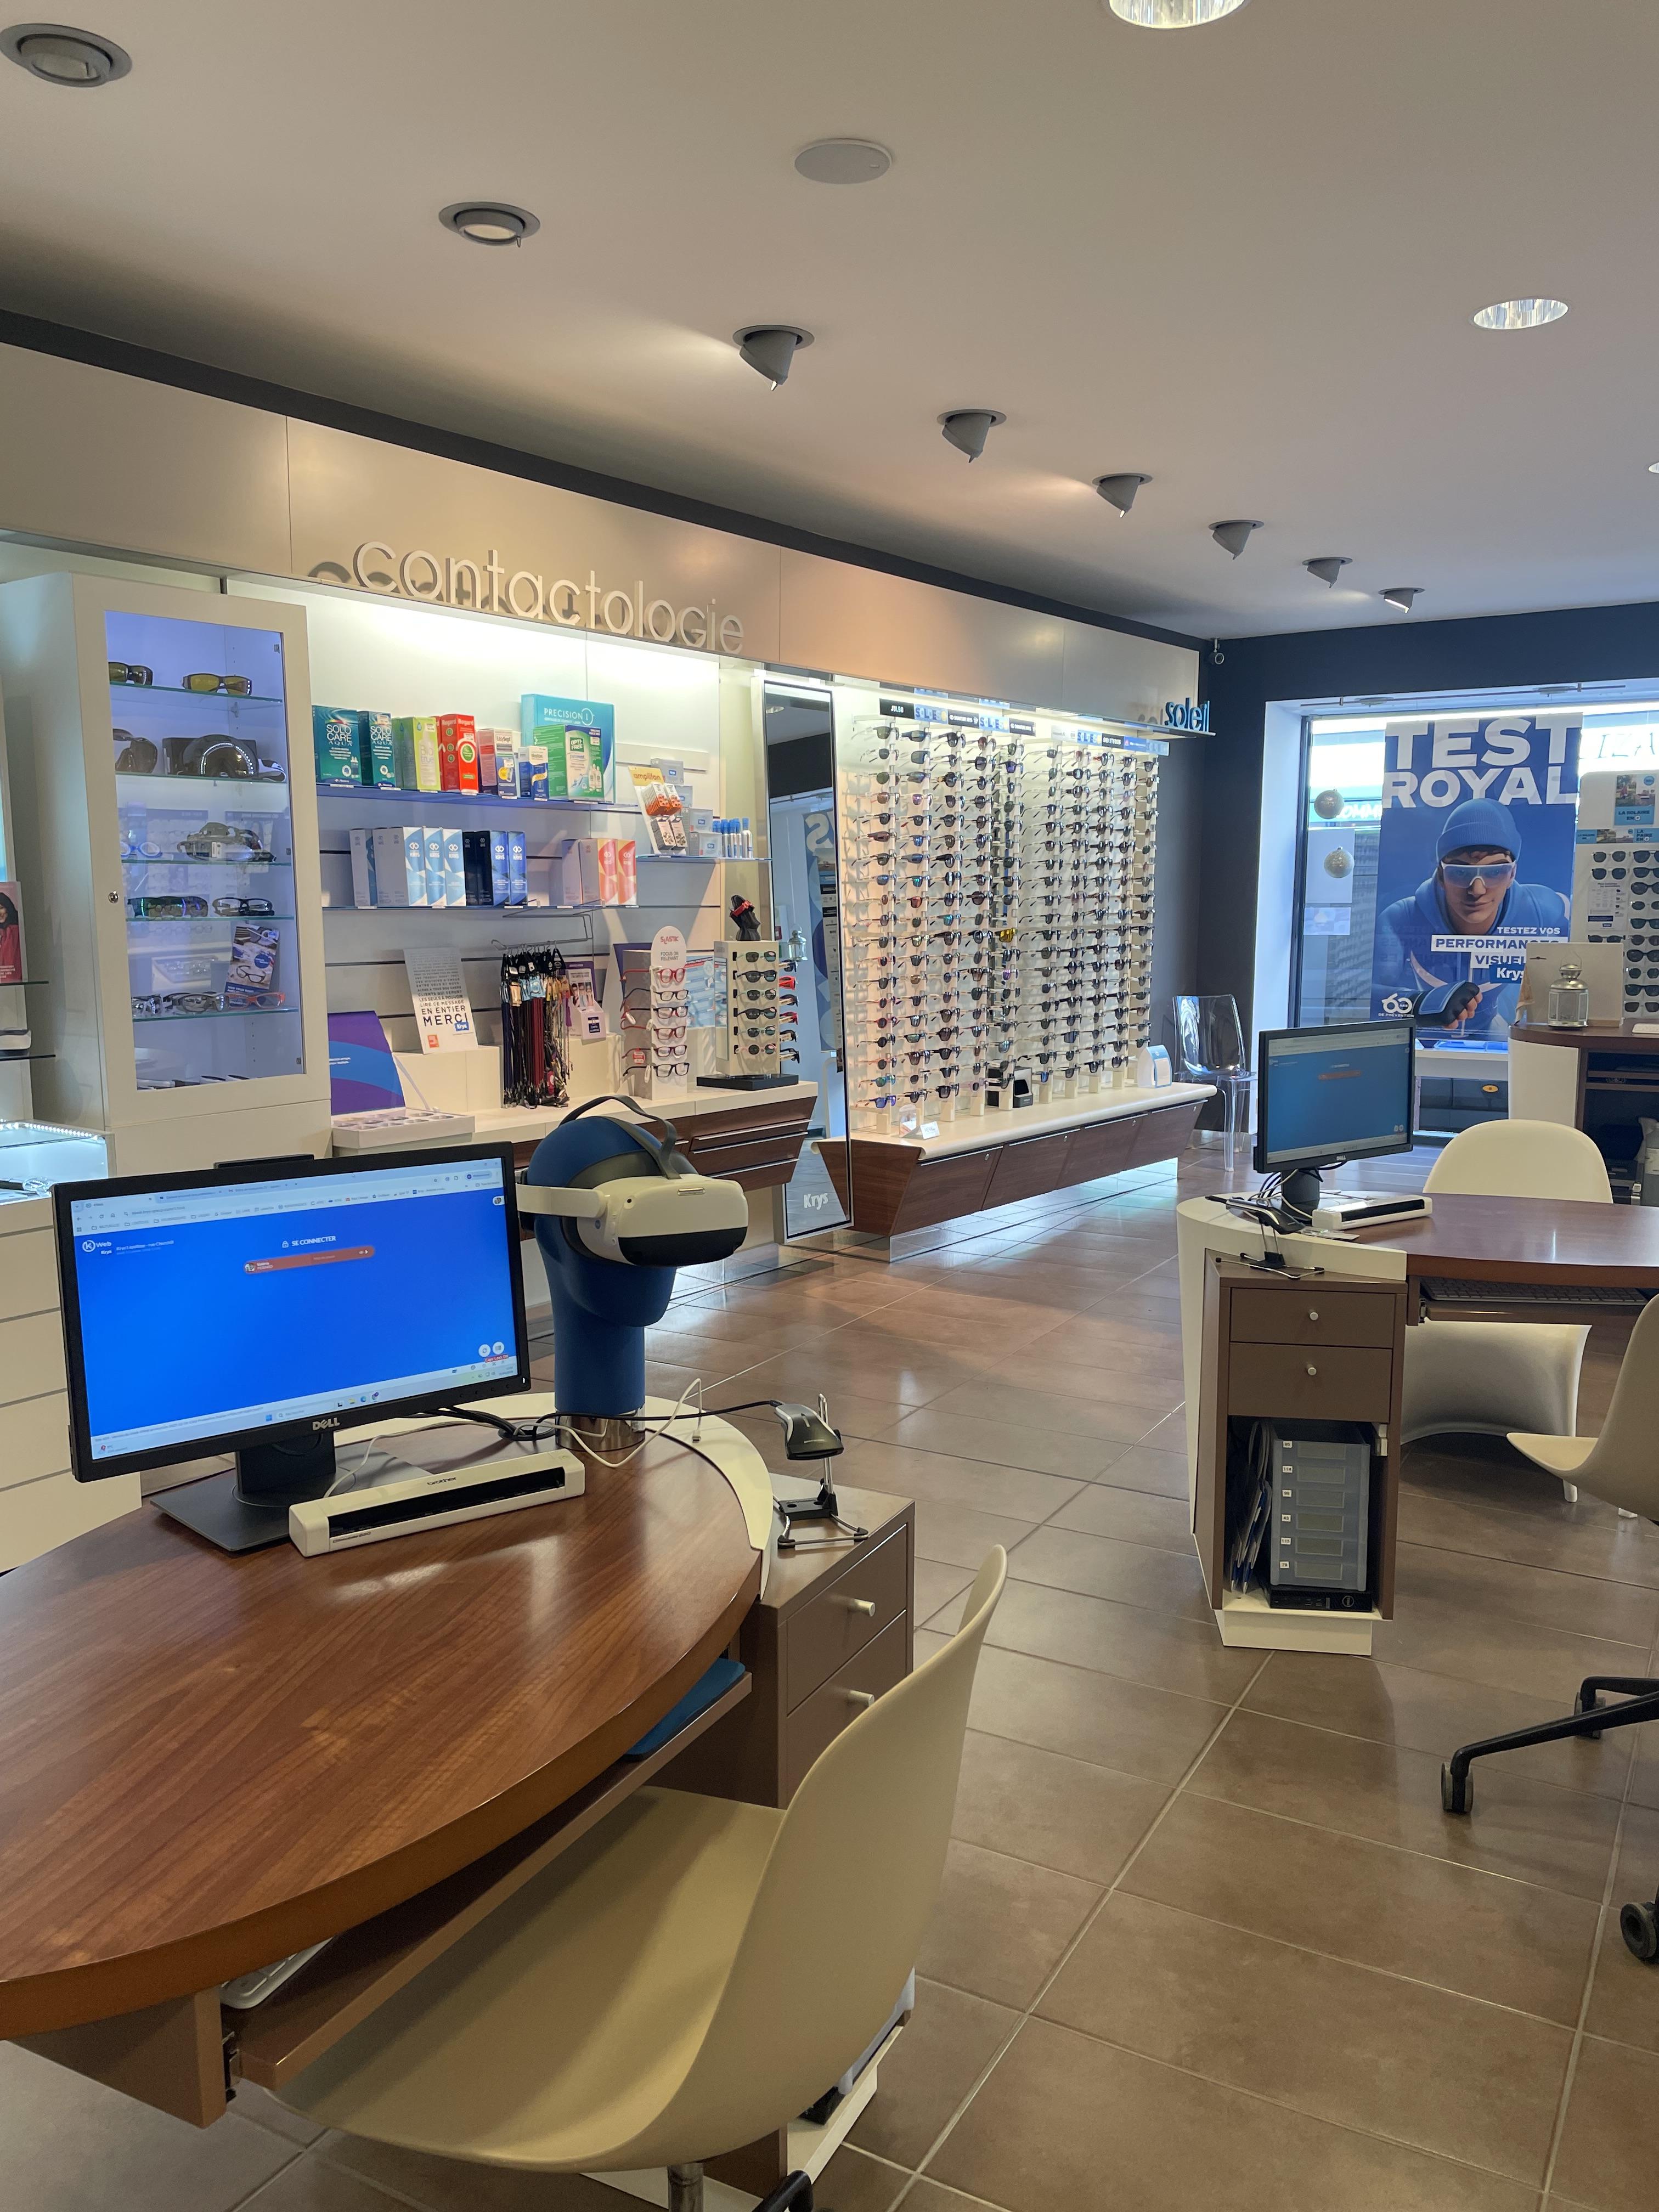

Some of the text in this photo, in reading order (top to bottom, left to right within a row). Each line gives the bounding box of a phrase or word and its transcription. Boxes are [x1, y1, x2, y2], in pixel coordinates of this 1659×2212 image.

[353, 541, 744, 654] contactologie
[544, 708, 583, 720] PRECISION
[1165, 697, 1210, 732] soleil
[326, 724, 352, 735] SOLO
[370, 725, 392, 735] SOLO
[326, 732, 352, 742] CARE
[370, 733, 392, 742] CARE
[1386, 712, 1583, 770] TEST
[634, 773, 661, 781] amplifon
[1383, 766, 1578, 809] ROYAL
[661, 936, 679, 944] SLASTIK
[1381, 993, 1413, 1014] 60
[436, 1005, 466, 1014] ENTIER
[423, 1013, 468, 1026] MERCI
[804, 1193, 828, 1210] Krys
[300, 1235, 336, 1245] CONNECTER
[312, 1417, 340, 1431] DELL
[426, 1476, 456, 1486] brother
